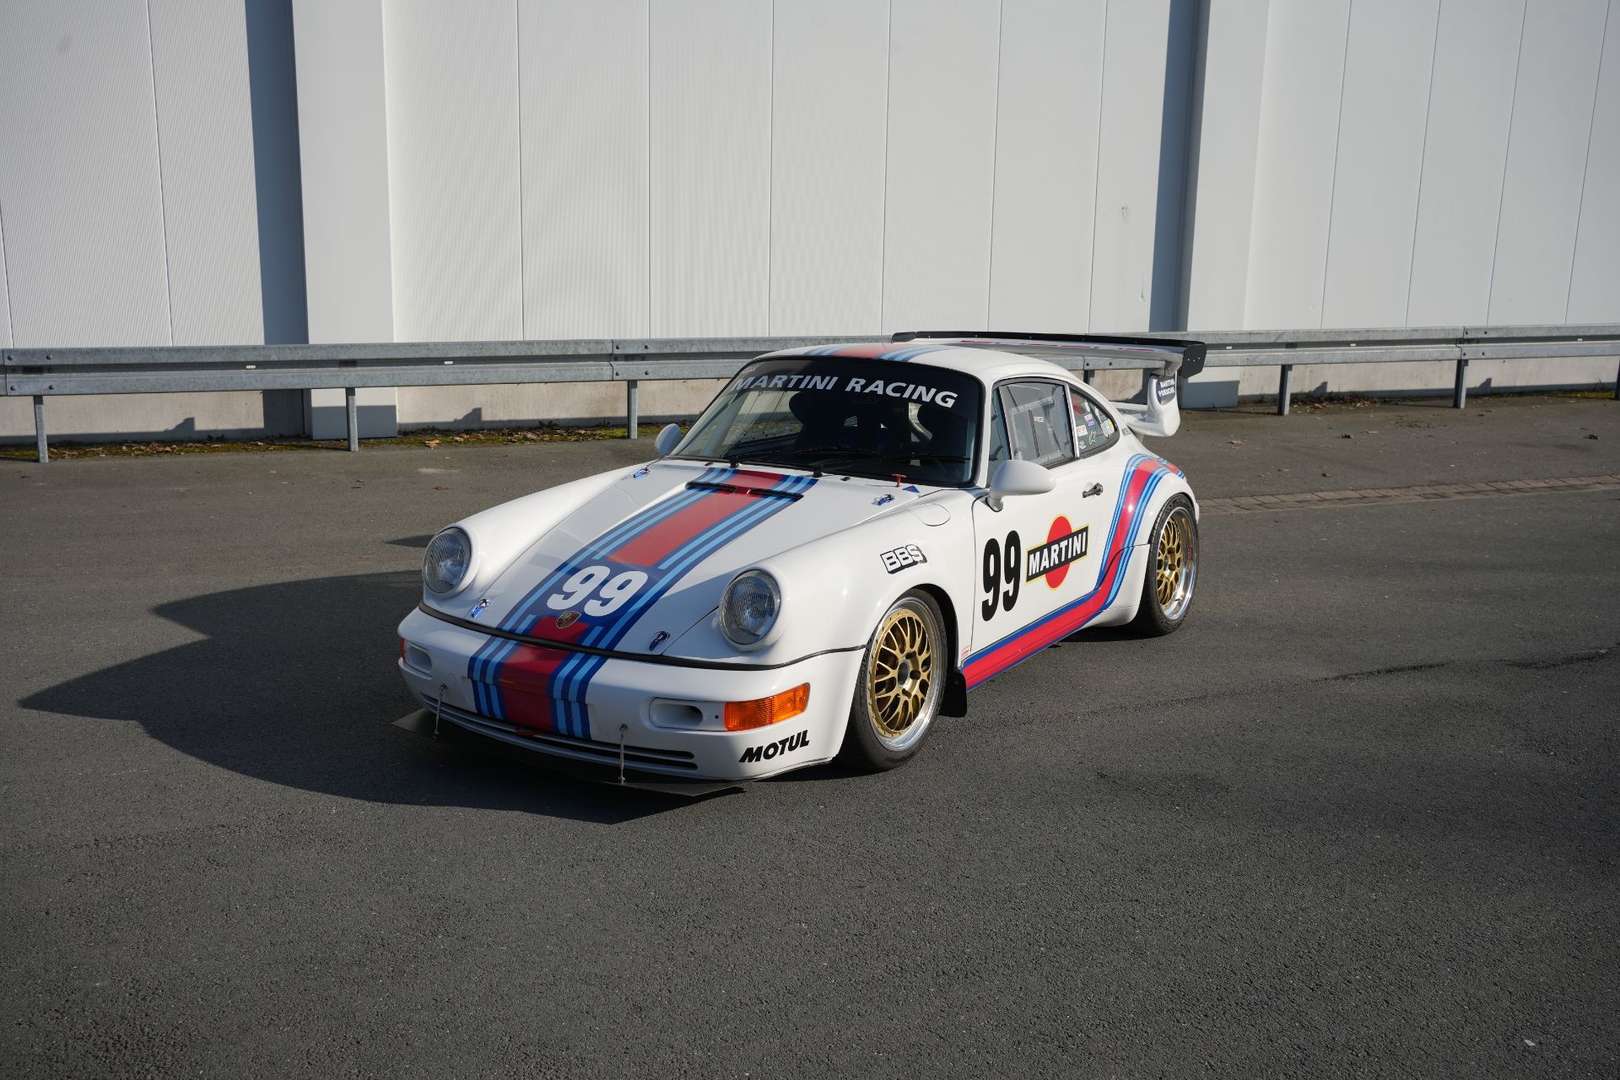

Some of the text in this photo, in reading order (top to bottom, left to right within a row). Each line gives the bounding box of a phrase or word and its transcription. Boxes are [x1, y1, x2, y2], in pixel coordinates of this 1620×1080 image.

[734, 375, 958, 408] MARTINI RACING
[880, 544, 927, 574] BBS
[1028, 531, 1087, 577] MARTINI
[547, 565, 648, 616] 99
[982, 530, 1021, 621] 99
[739, 729, 809, 762] MOTUL
